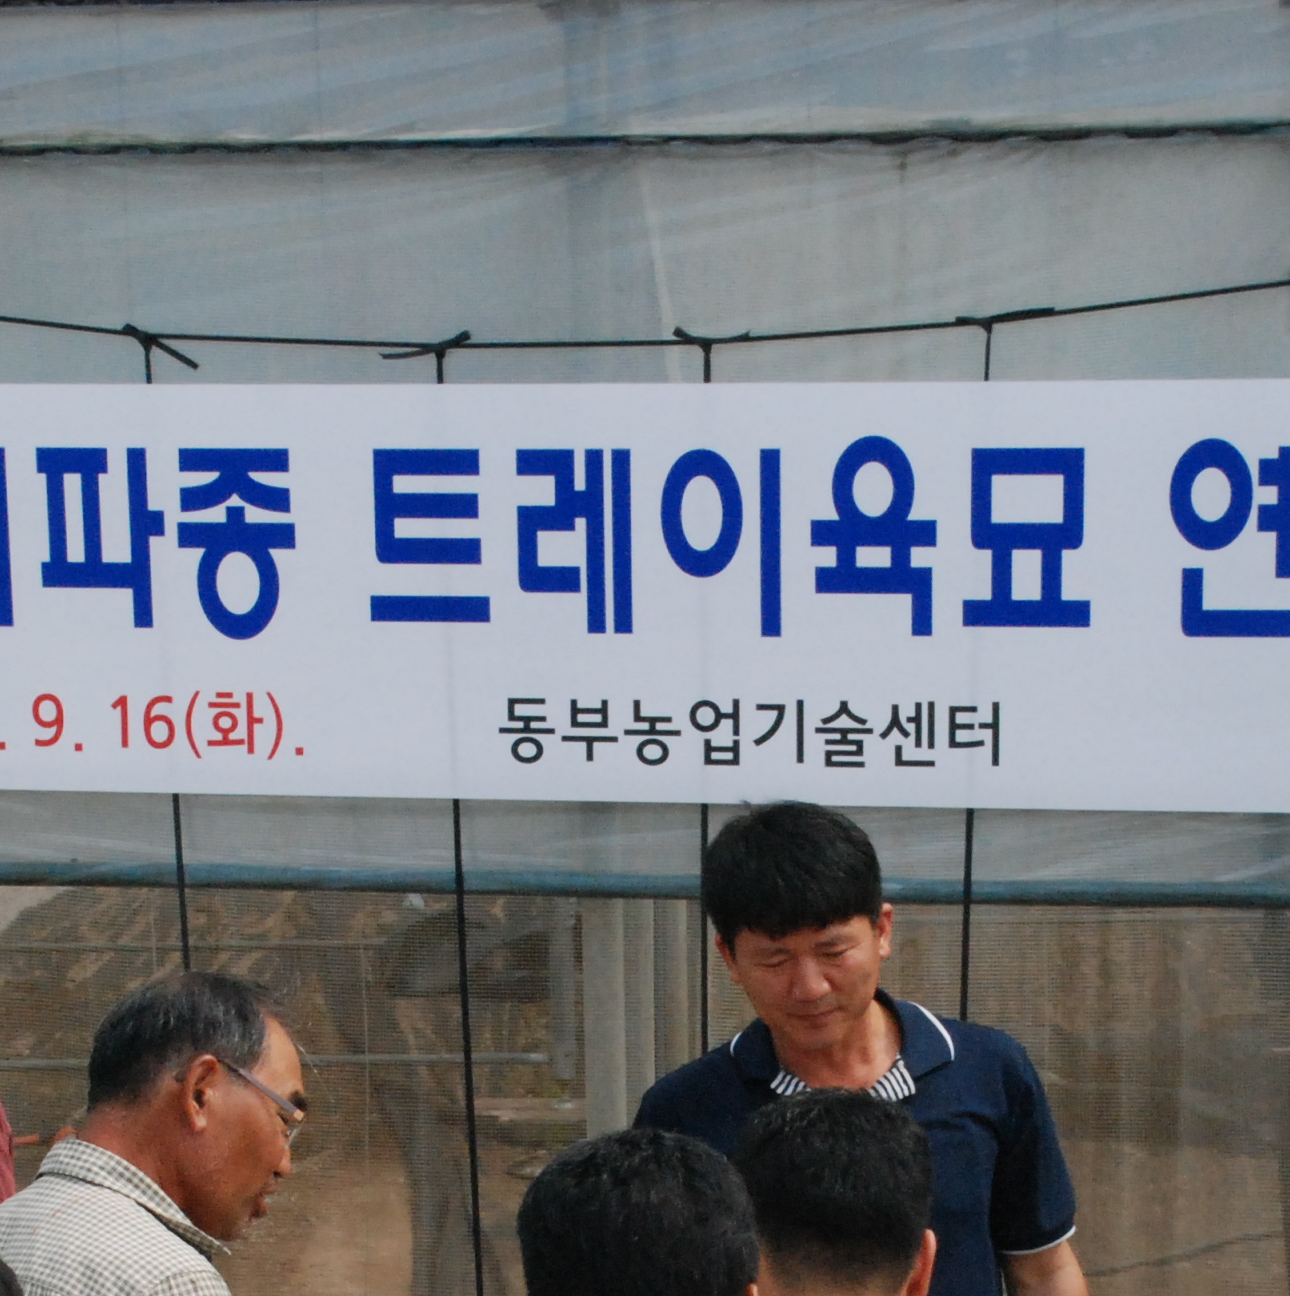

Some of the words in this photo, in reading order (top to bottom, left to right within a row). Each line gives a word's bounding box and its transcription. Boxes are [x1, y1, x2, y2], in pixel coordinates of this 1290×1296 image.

[371, 436, 1091, 637] 트레이육묘
[32, 693, 84, 752] 9.
[111, 690, 304, 760] 16(화).
[499, 698, 1001, 767] 동부농업기술센터
